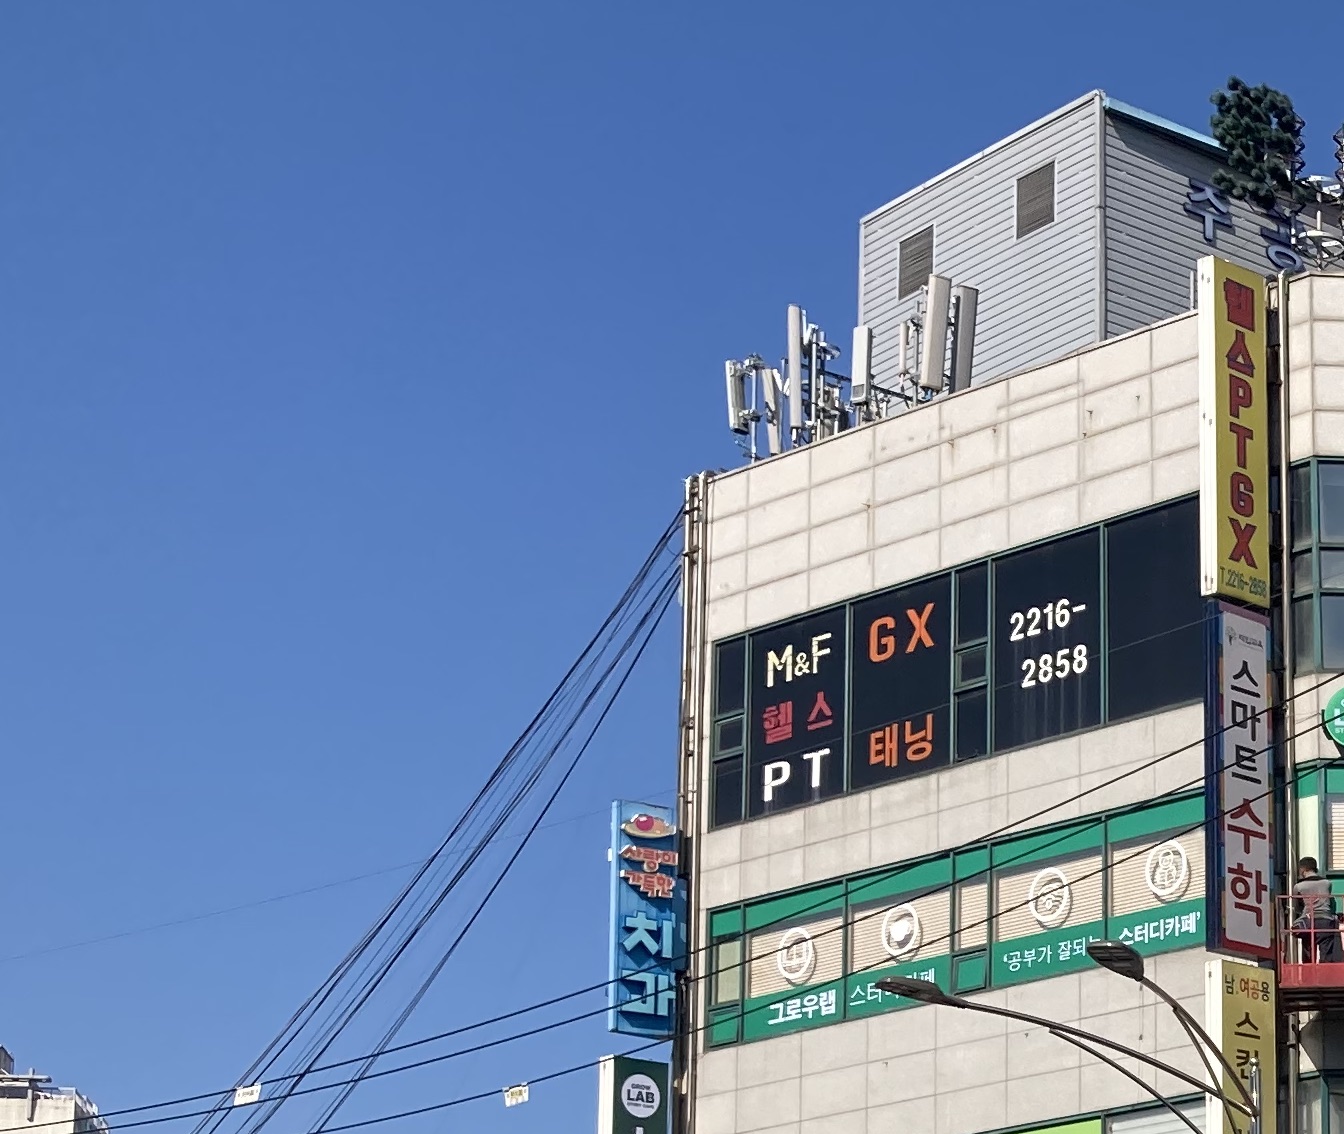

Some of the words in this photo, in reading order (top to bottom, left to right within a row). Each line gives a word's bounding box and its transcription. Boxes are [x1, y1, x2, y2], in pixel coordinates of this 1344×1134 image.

[868, 602, 935, 663] GX
[1009, 599, 1087, 642] 2216-
[766, 633, 832, 688] M&F
[1021, 644, 1088, 689] 2858
[762, 691, 833, 745] 헬스
[869, 713, 935, 768] 태닝
[763, 747, 830, 802] PT
[619, 844, 678, 872] 사랑이
[620, 869, 676, 898] 가득한
[621, 910, 675, 1017] 치과
[767, 993, 837, 1027] 그로우랩
[849, 966, 936, 1006] 스터카페
[626, 1090, 655, 1105] LAB
